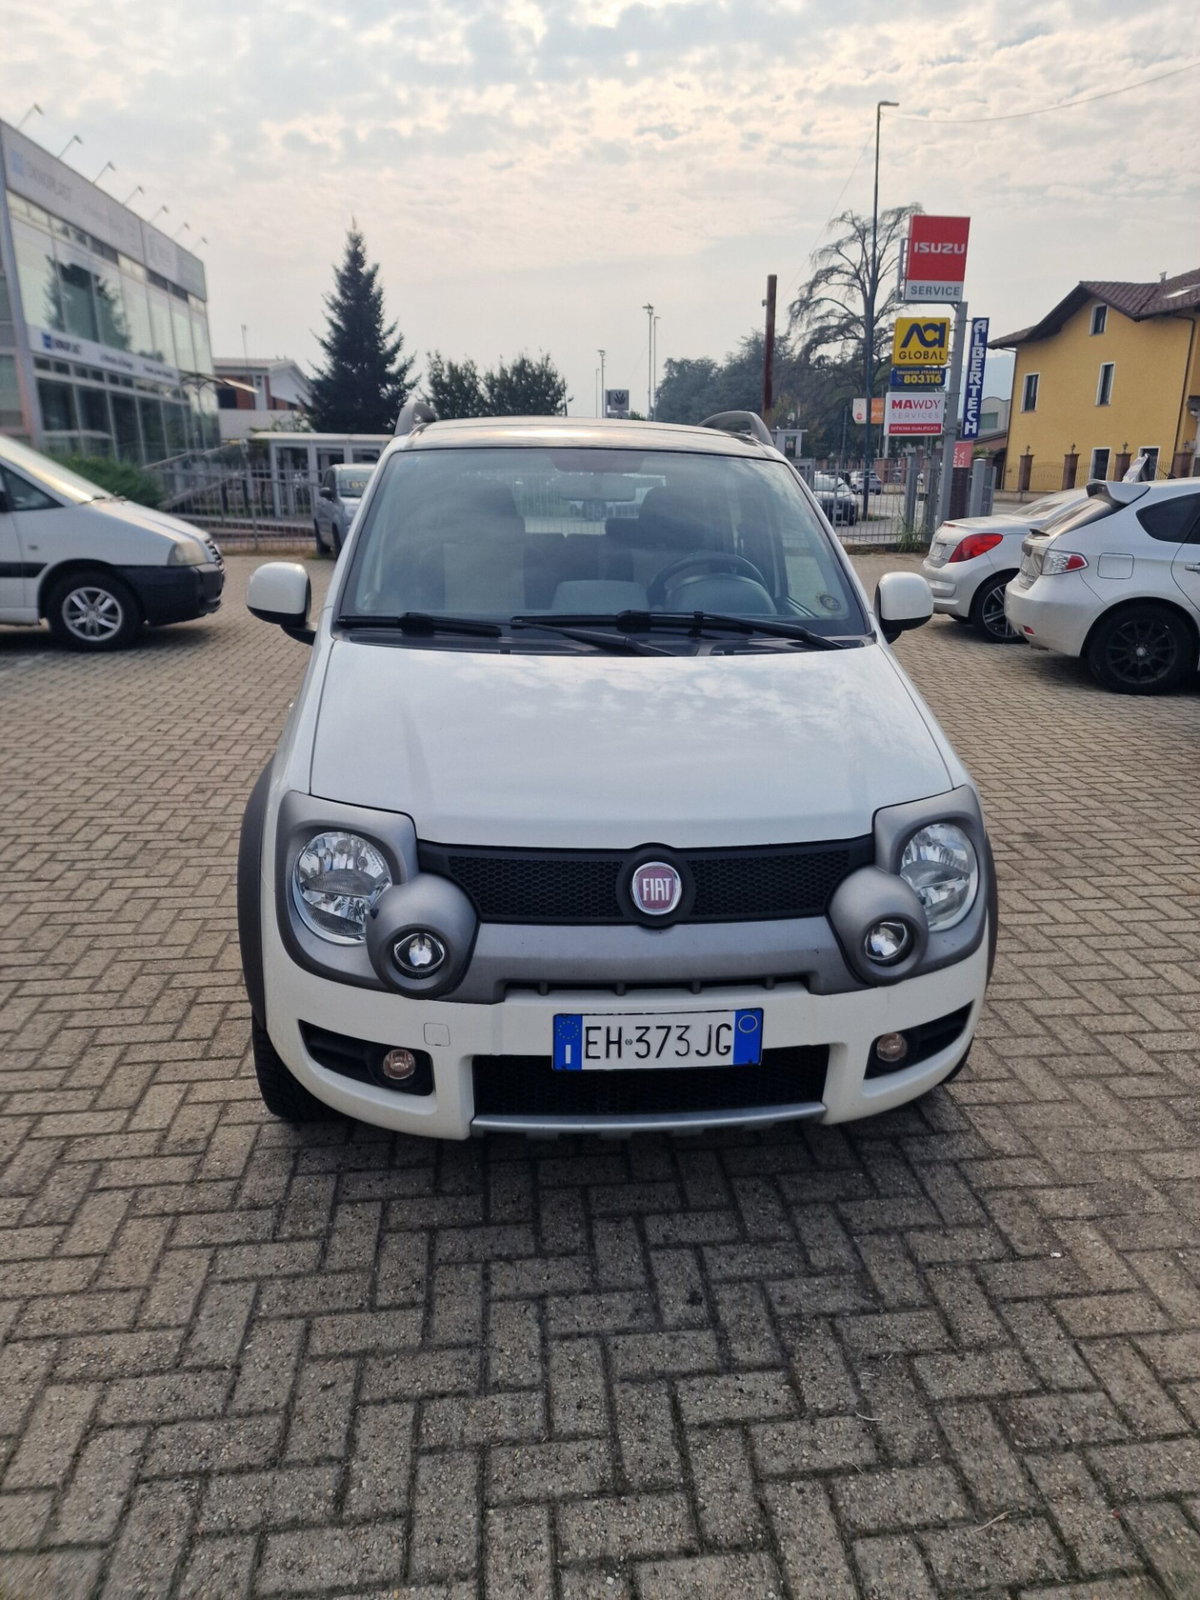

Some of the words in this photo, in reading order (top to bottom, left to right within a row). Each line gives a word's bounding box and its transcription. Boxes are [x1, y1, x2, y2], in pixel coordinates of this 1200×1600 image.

[914, 242, 965, 254] ISUZU
[910, 285, 960, 296] SERVICE
[900, 322, 946, 349] ACI
[898, 350, 944, 360] GLOBAL
[964, 319, 987, 435] ALBERTECH
[891, 399, 941, 409] MAWDY
[891, 411, 939, 419] SERVICES
[642, 877, 671, 901] FIAT
